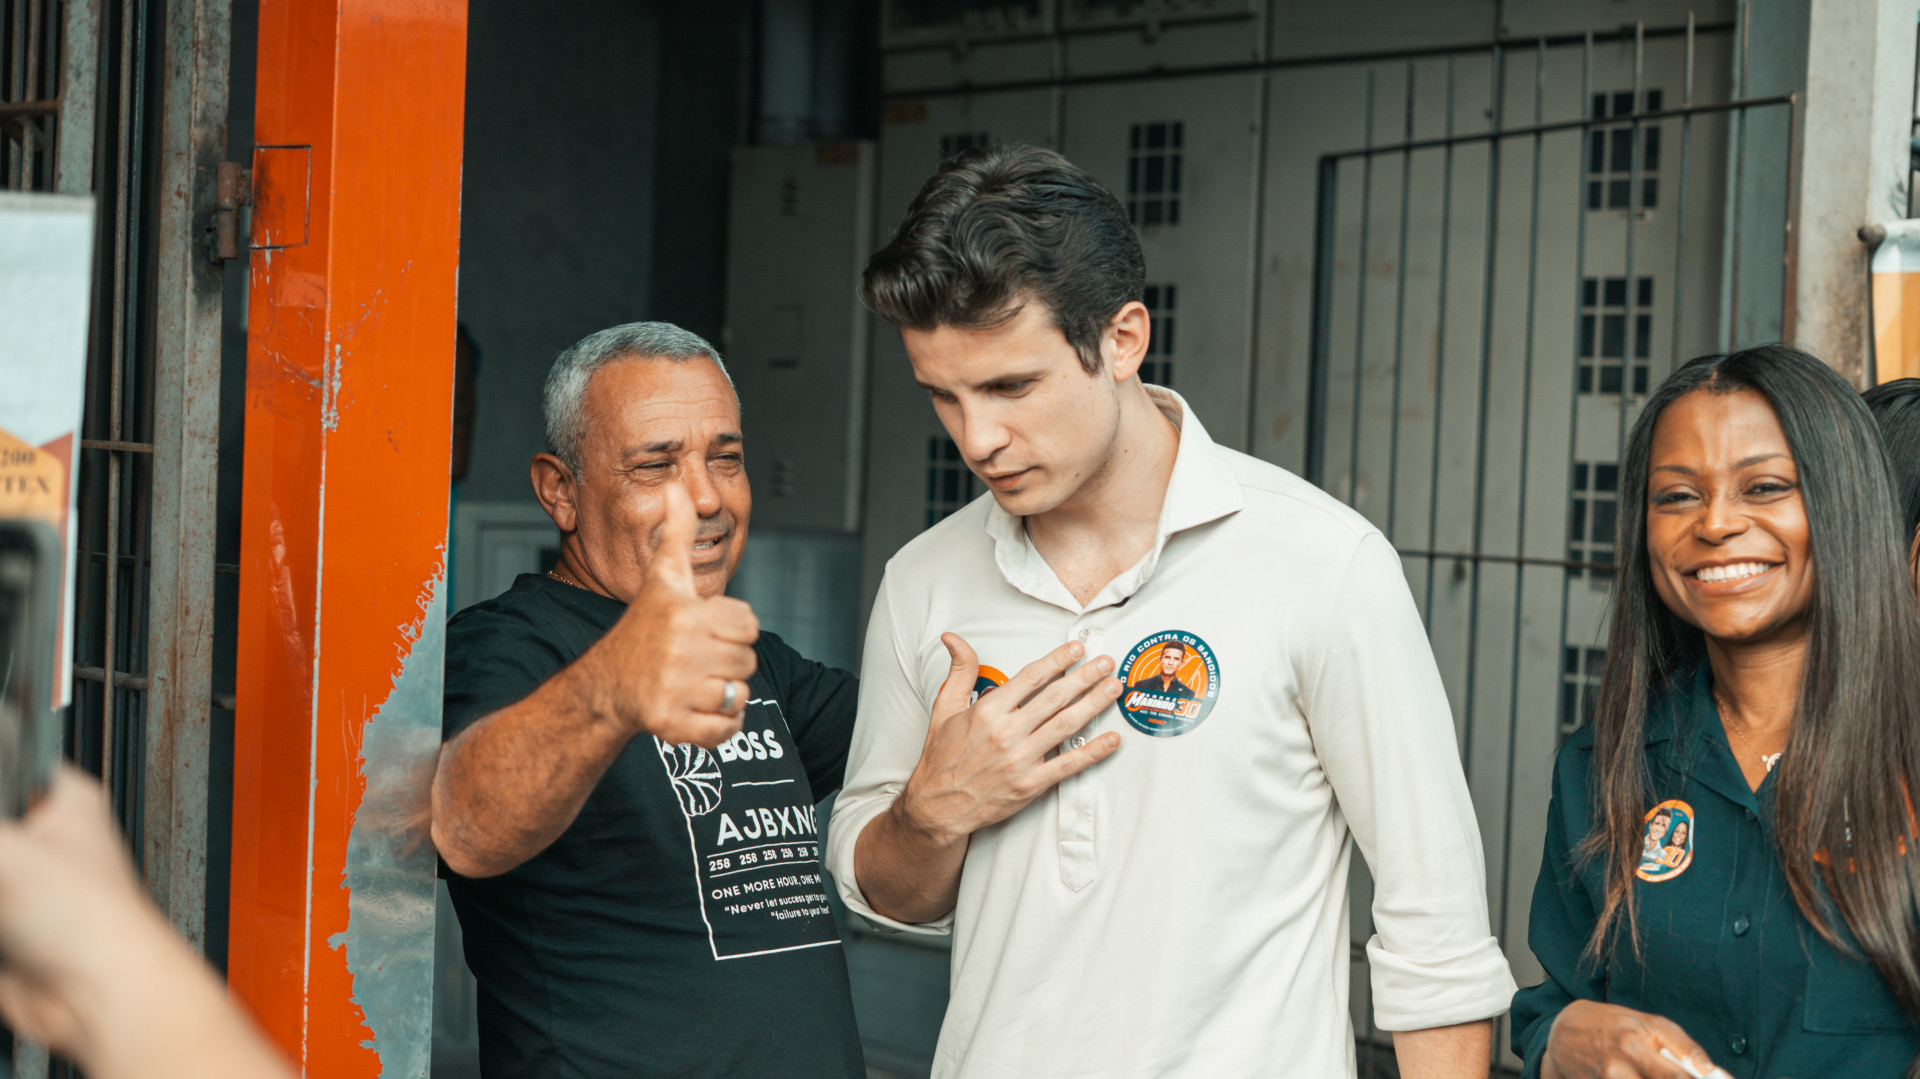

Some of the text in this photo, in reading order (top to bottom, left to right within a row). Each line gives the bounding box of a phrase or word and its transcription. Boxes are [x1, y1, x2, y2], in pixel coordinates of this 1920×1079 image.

[0, 475, 50, 494] TEX
[1123, 654, 1136, 671] RIO
[1137, 633, 1178, 652] CONTRA
[1182, 635, 1197, 646] OS
[1197, 645, 1216, 697] BANDIDOS
[1174, 698, 1201, 718] 30
[717, 729, 784, 763] BOSS
[709, 857, 731, 871] 258
[739, 852, 758, 865] 258
[762, 849, 777, 861] 258
[780, 847, 794, 859] 258
[797, 846, 809, 858] 258
[1655, 846, 1685, 868] 30
[711, 885, 741, 900] ONE
[743, 878, 776, 894] MORE
[776, 875, 802, 888] HOUR,
[800, 874, 815, 885] ONE
[765, 898, 778, 908] let
[778, 895, 806, 906] success
[801, 908, 810, 917] to
